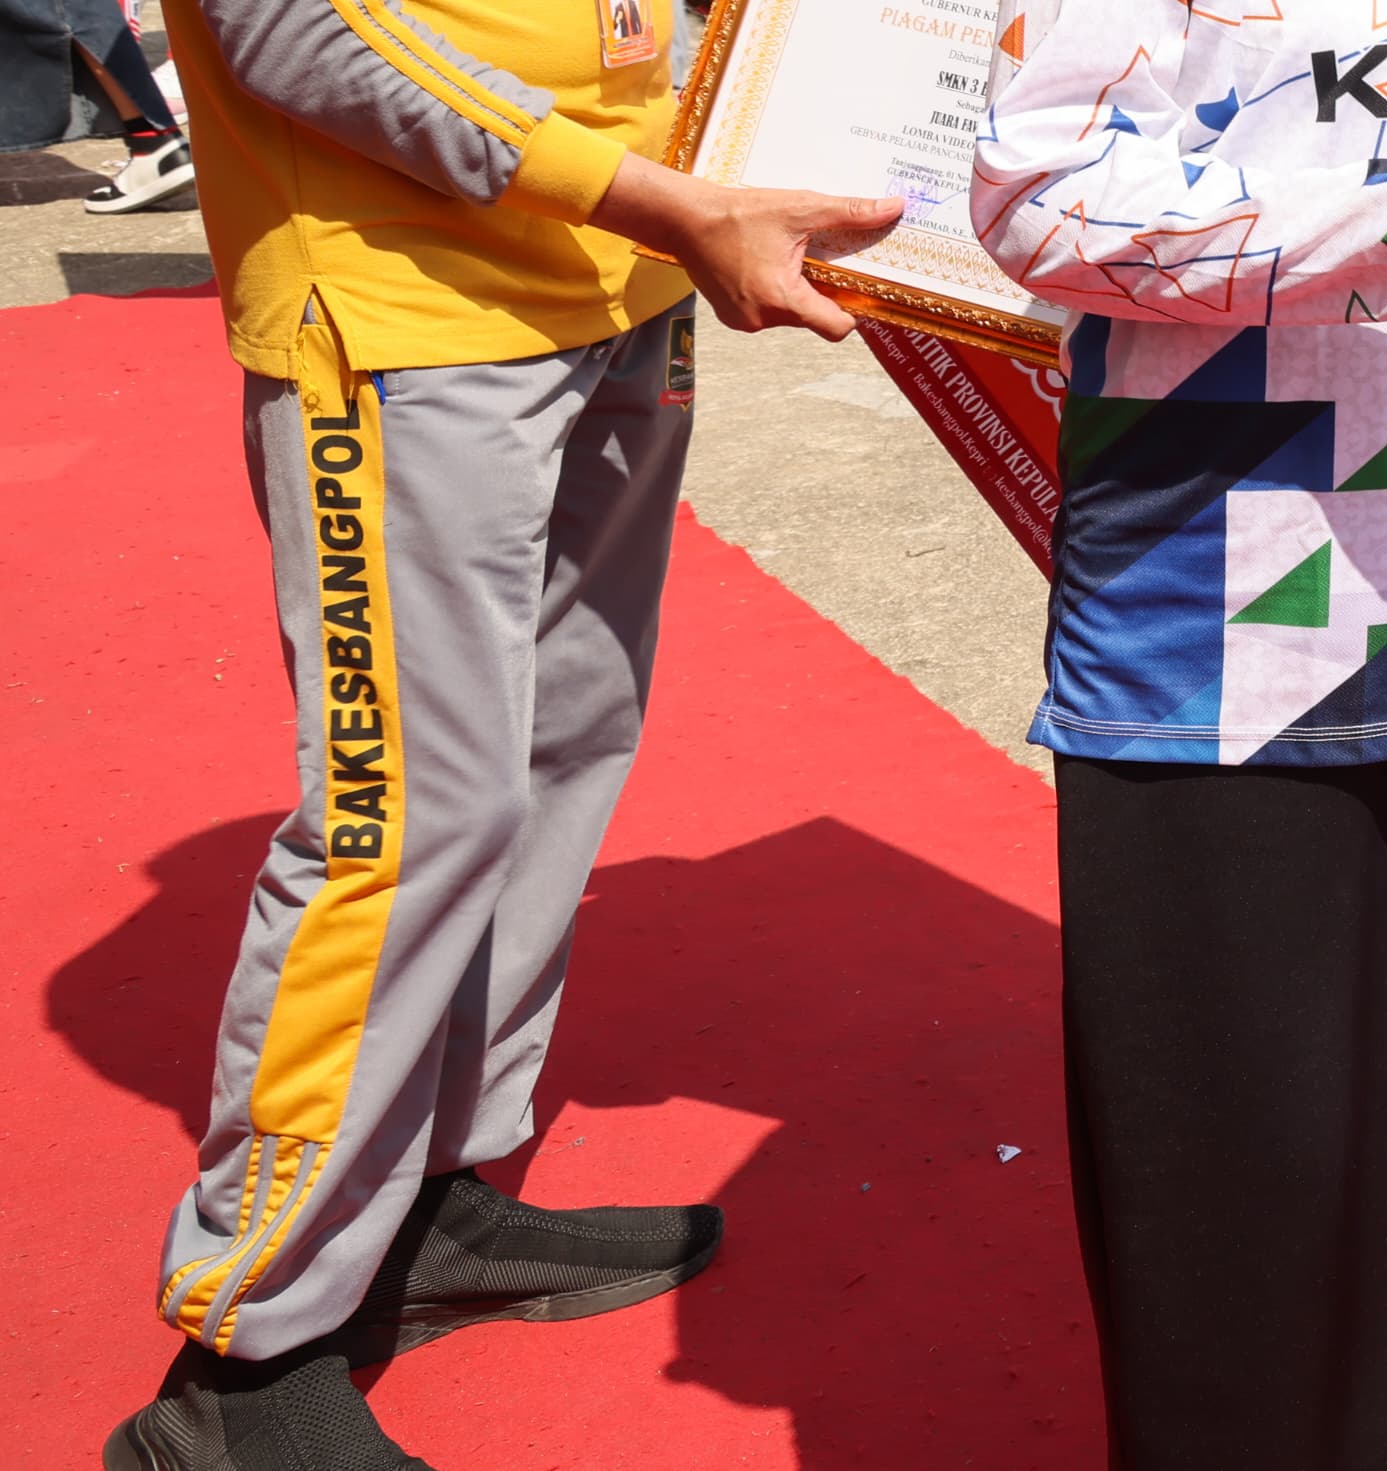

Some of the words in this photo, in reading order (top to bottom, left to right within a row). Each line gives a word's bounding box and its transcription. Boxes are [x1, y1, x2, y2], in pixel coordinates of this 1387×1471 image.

[880, 7, 957, 40] PIAGAM
[960, 25, 995, 48] PEN
[936, 70, 969, 90] SMKN
[969, 78, 979, 94] 3
[929, 110, 960, 130] JUARA
[955, 99, 986, 114] Sebaga
[850, 125, 888, 142] GEBYAR
[889, 134, 929, 153] PELAJAR
[930, 145, 975, 164] PANCASIL
[902, 124, 940, 143] LOMBA
[943, 134, 976, 151] VIDEO
[934, 178, 970, 193] KEPULA
[949, 371, 1017, 456] PROVINSI
[1004, 447, 1061, 523] KEPULA
[310, 398, 388, 860] BAKESBANGPOL
